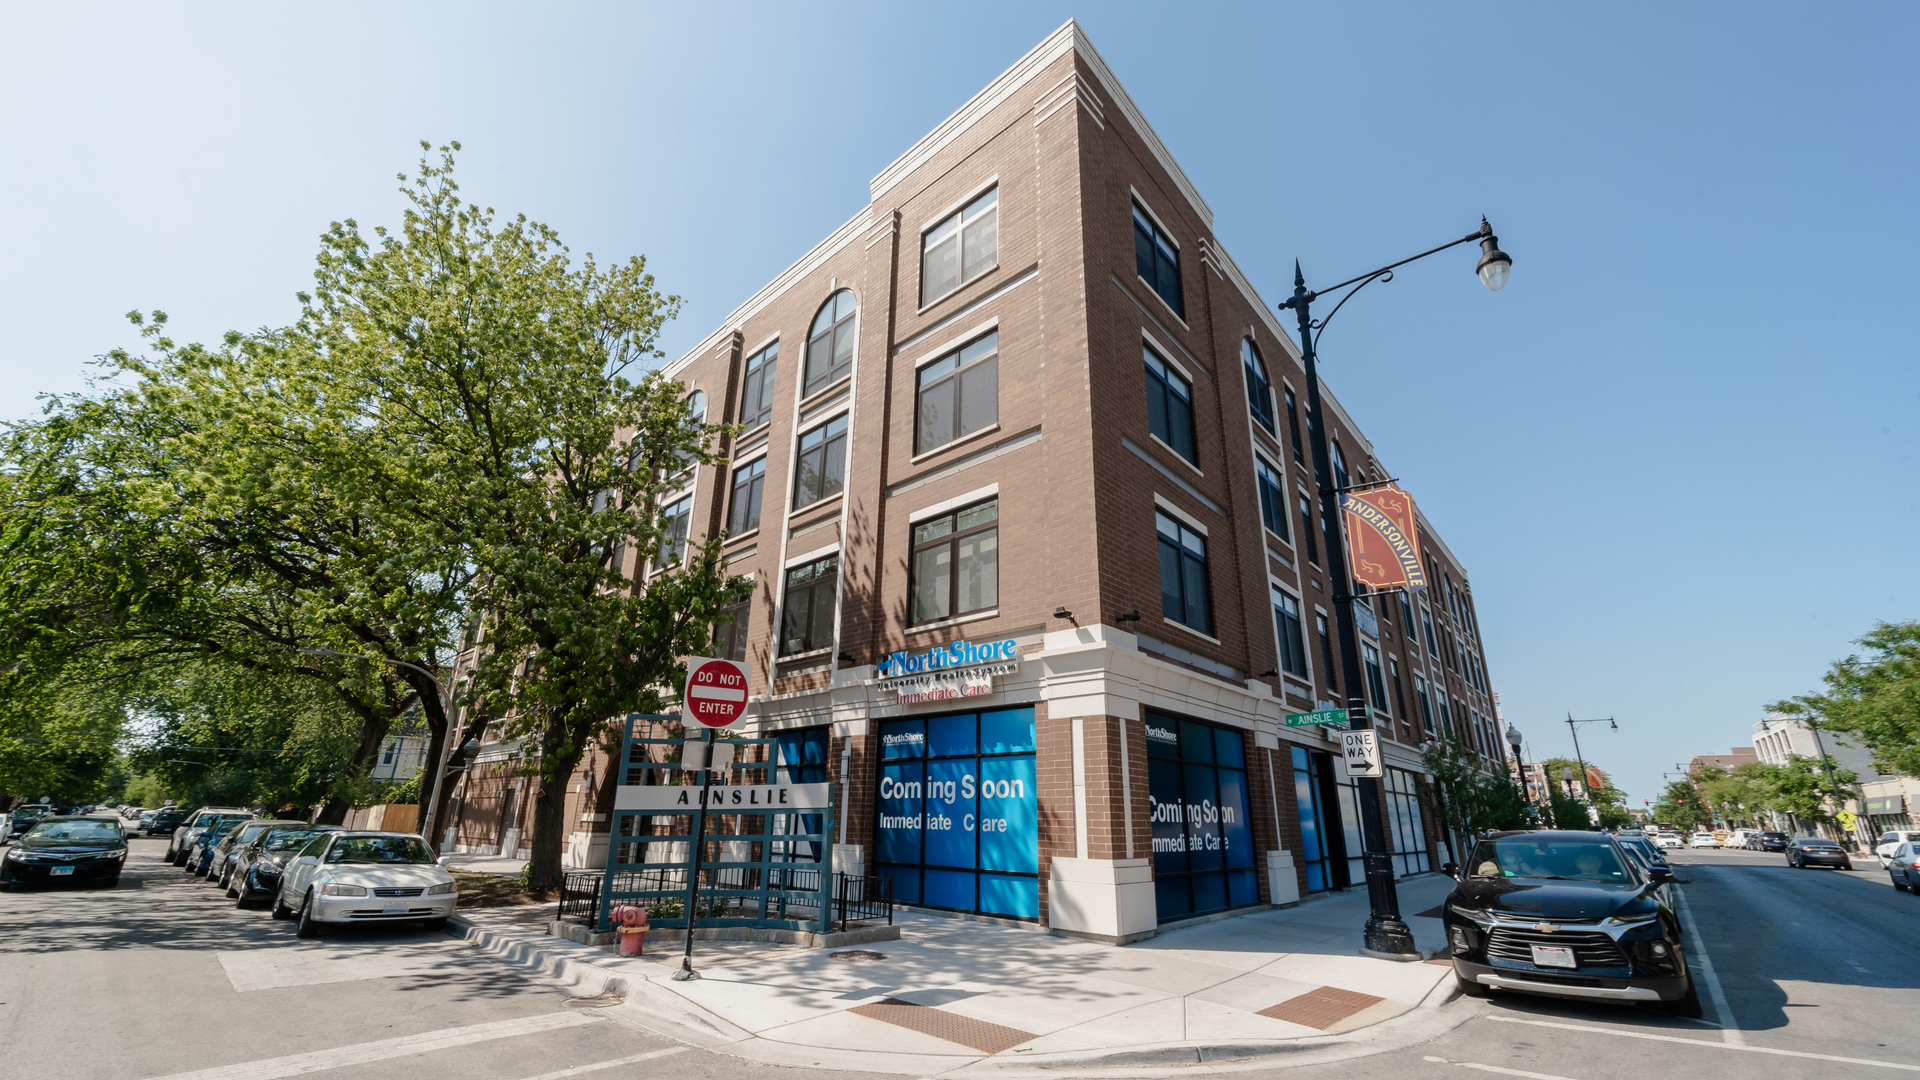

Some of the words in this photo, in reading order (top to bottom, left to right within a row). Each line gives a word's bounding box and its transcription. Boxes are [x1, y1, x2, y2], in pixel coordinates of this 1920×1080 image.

[1343, 498, 1424, 586] ANDERSONVILLE
[892, 639, 1017, 674] NorthShore
[698, 671, 713, 683] DO
[720, 674, 741, 686] NOT
[878, 676, 930, 690] University
[896, 687, 956, 704] Immediate
[960, 683, 989, 697] Care
[699, 702, 734, 715] ENTER
[1298, 712, 1332, 724] AINSLIE
[886, 733, 924, 743] NorthShore
[1145, 725, 1177, 741] NorthShore
[1346, 734, 1372, 746] ONE
[1346, 747, 1373, 758] WAY
[880, 775, 956, 804] Coming
[961, 774, 1024, 799] Soon
[1149, 795, 1201, 828] Coming
[1202, 799, 1234, 823] Soon
[880, 812, 952, 830] Immediate
[963, 813, 1007, 832] Care
[1152, 833, 1202, 852] mmediate
[1205, 833, 1230, 851] Care
